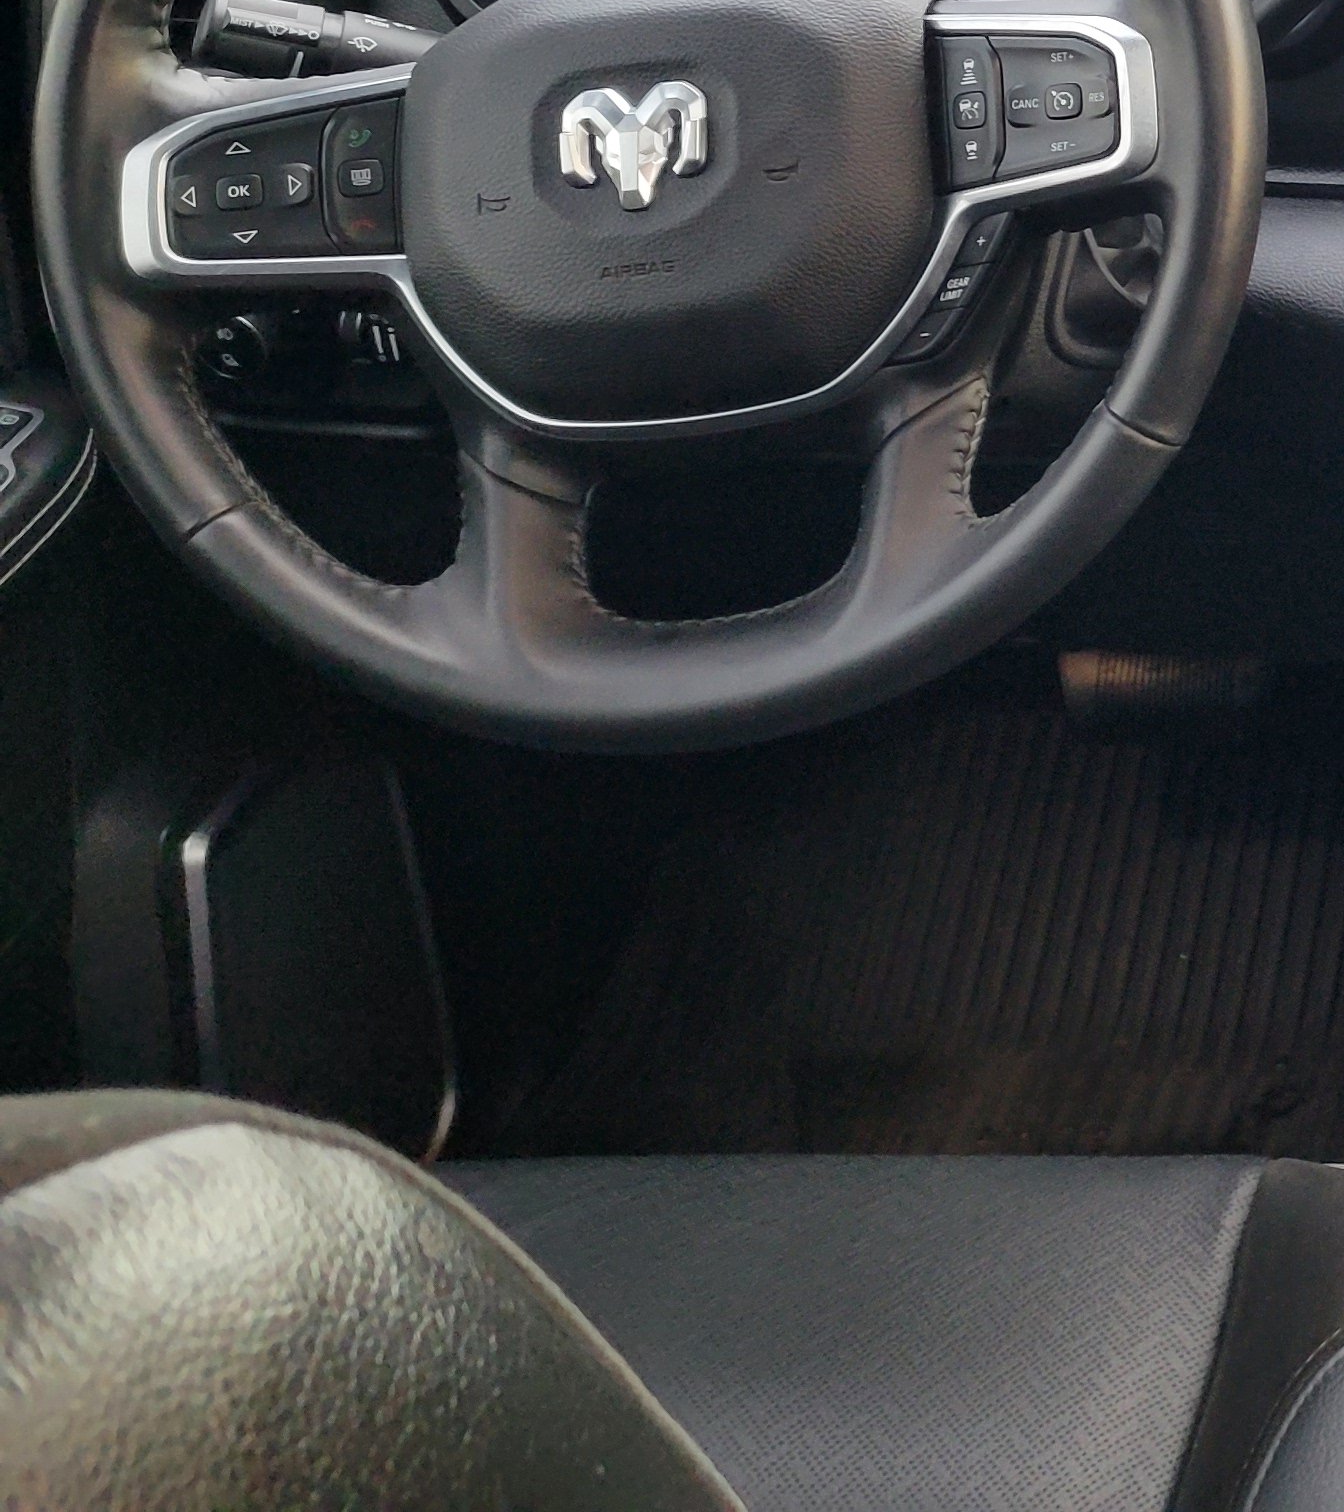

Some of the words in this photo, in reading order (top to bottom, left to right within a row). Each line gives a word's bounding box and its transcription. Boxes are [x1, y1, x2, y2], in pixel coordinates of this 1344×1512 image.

[1088, 91, 1105, 103] RES
[1011, 98, 1039, 110] CANC
[227, 185, 251, 198] OK
[946, 276, 970, 289] GEAR
[940, 288, 964, 302] LIMIT
